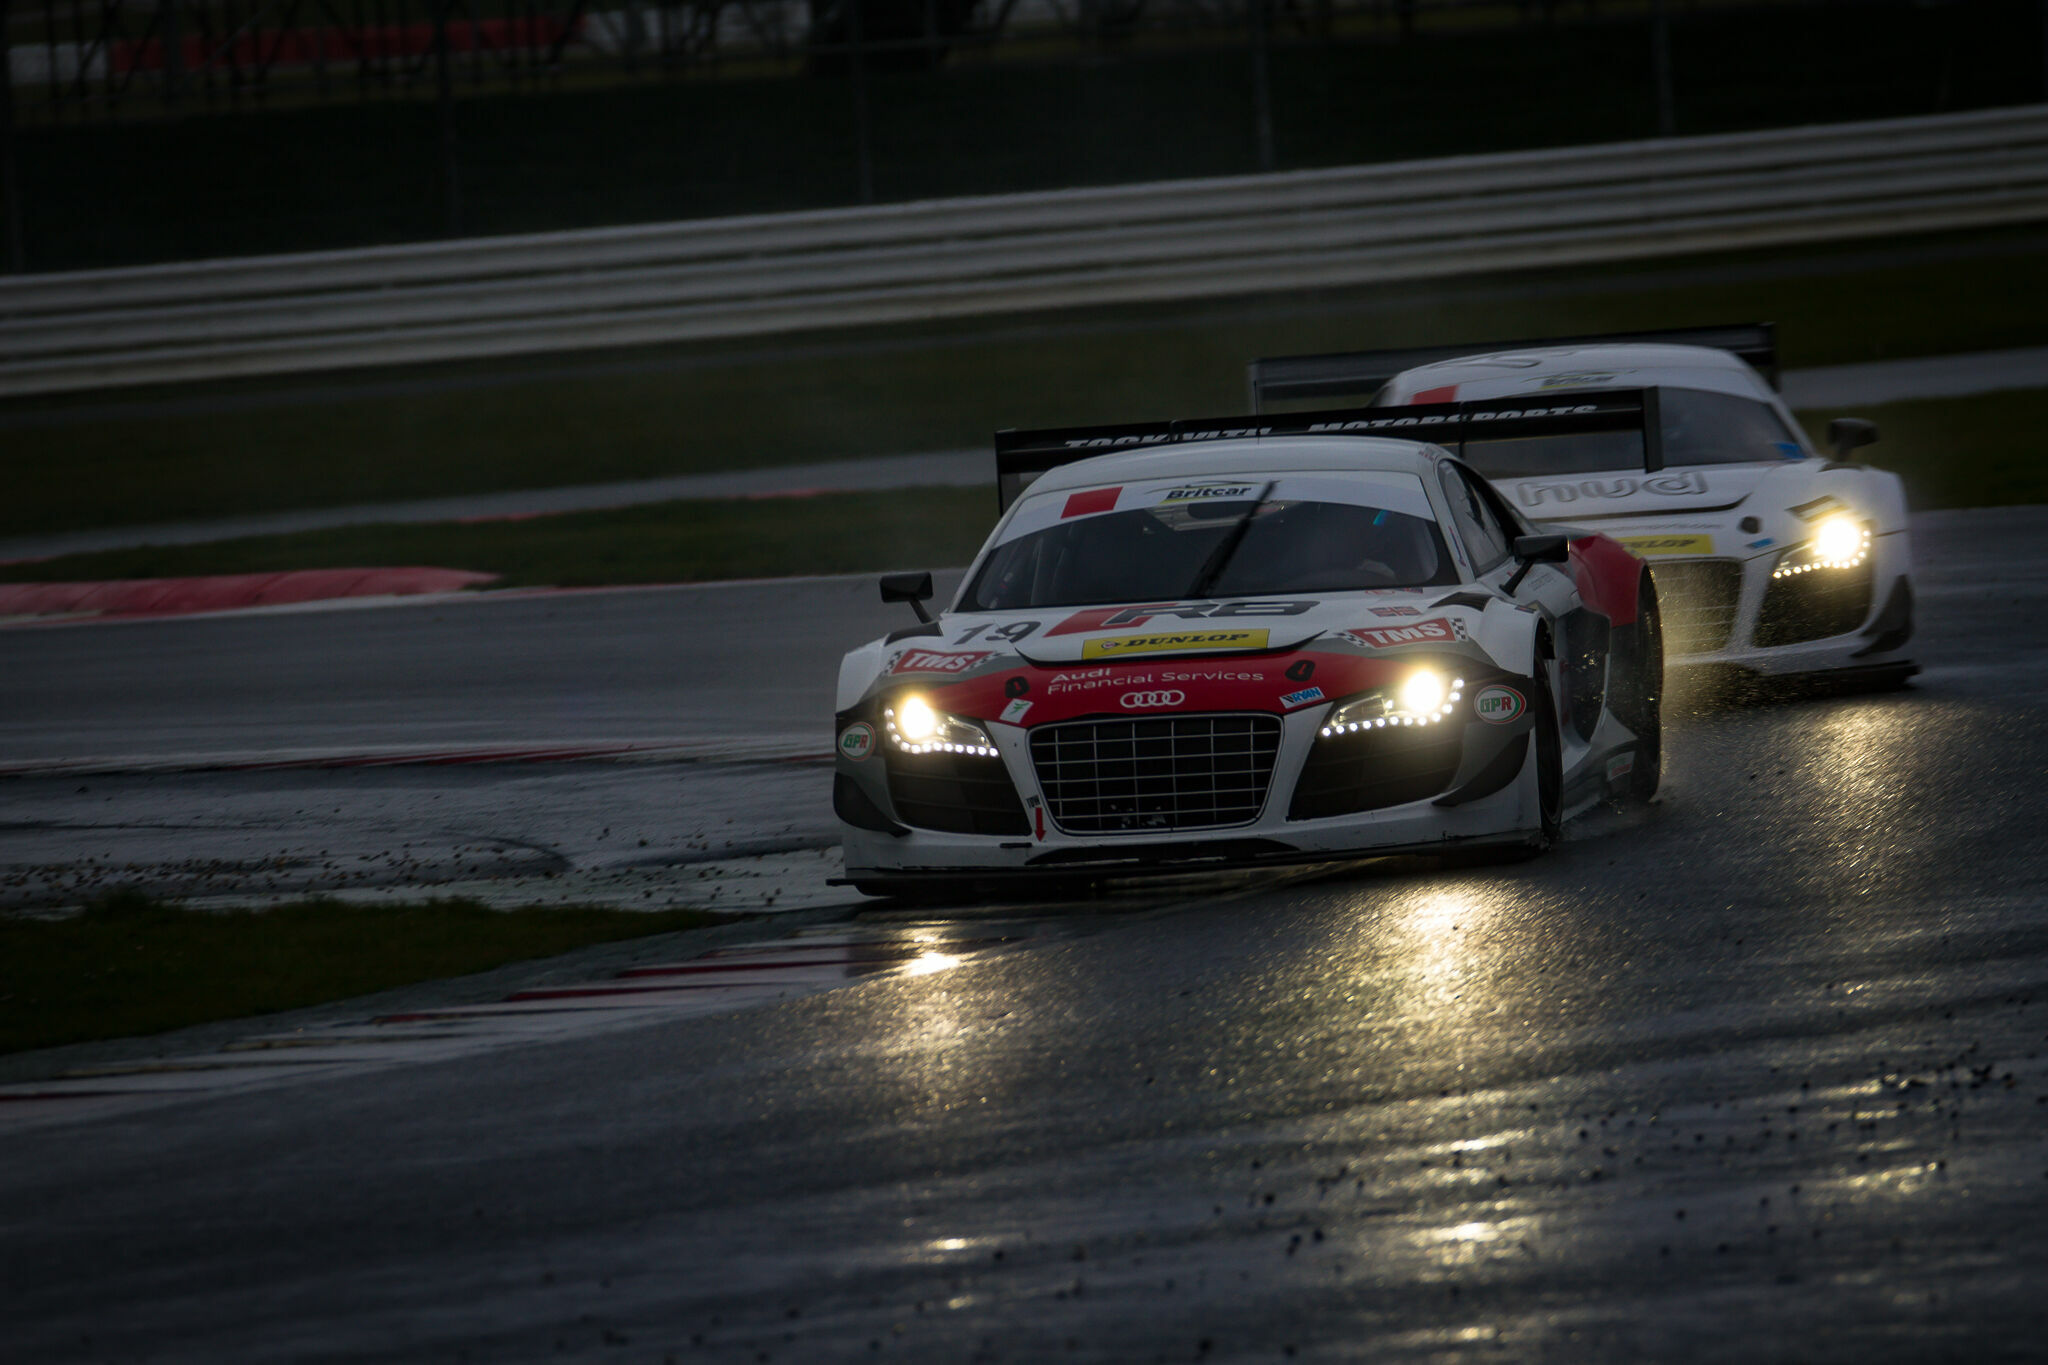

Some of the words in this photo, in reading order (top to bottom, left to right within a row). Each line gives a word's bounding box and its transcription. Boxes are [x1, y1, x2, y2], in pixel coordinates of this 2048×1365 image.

[1166, 486, 1252, 500] Britcar
[953, 621, 1042, 646] 19
[1124, 633, 1250, 648] DUNLOP
[1364, 622, 1448, 645] TMS
[902, 652, 976, 670] TMS
[1047, 673, 1154, 695] Financial
[1160, 671, 1265, 683] Services
[1050, 668, 1112, 683] Audi
[1480, 696, 1513, 713] GPR
[843, 736, 869, 750] GPR
